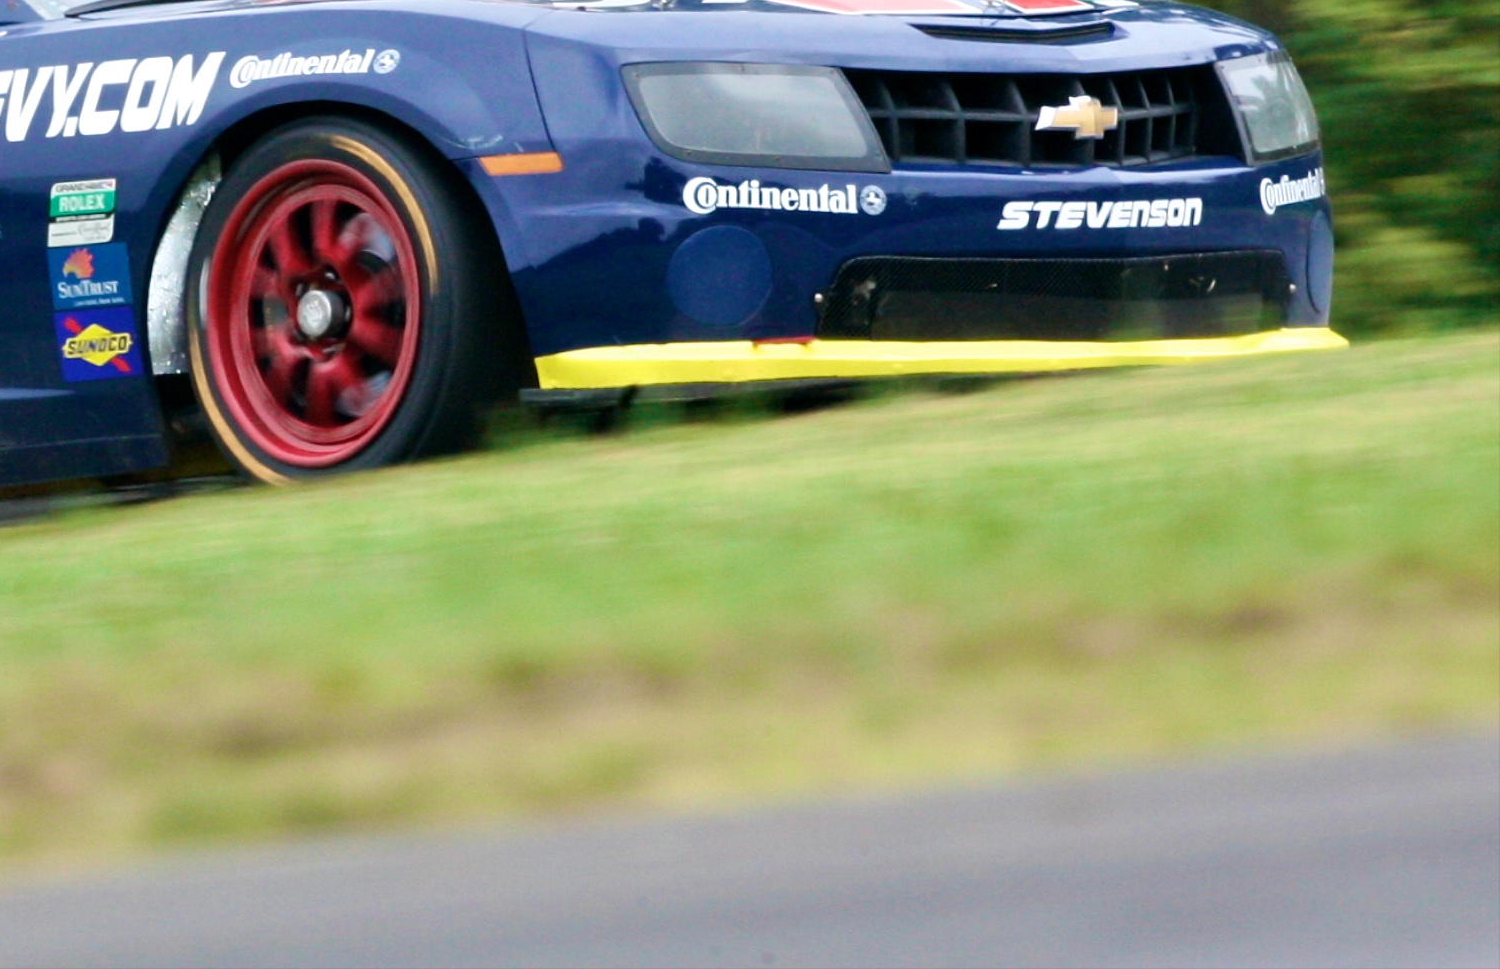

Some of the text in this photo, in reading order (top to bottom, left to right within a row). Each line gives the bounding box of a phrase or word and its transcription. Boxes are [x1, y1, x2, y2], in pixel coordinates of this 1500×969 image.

[230, 49, 375, 88] Continental
[59, 194, 105, 212] ROLEX
[683, 176, 859, 215] Continental
[997, 198, 1203, 230] STEVENSON
[67, 335, 128, 355] SUNOCO
